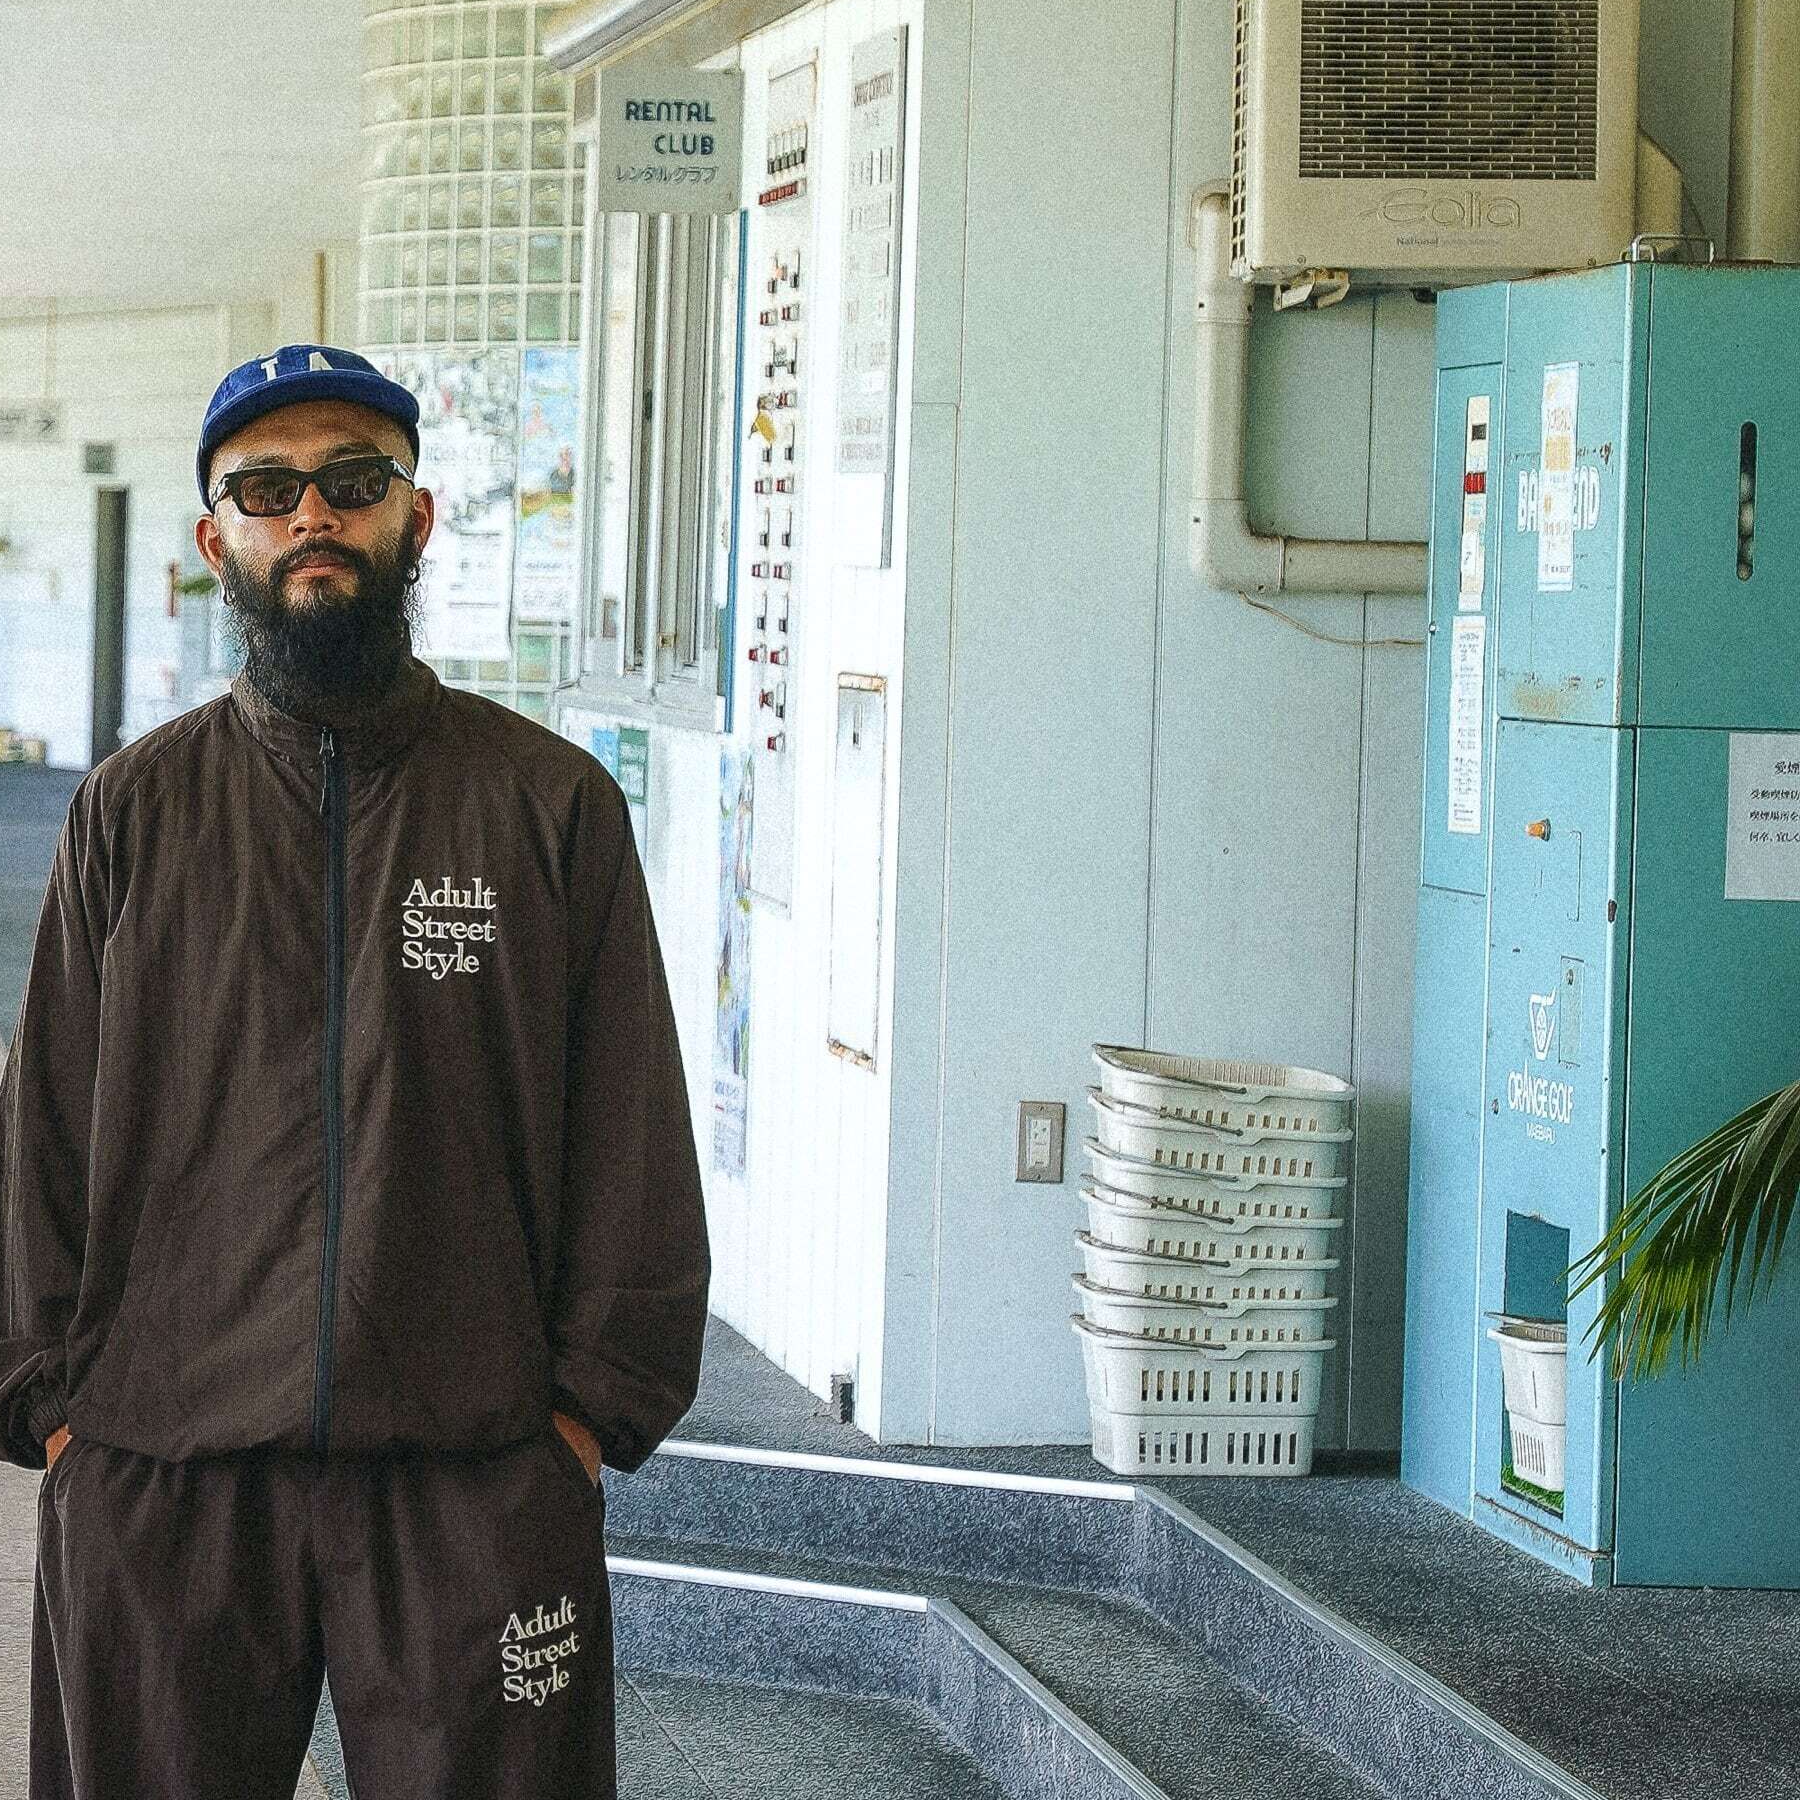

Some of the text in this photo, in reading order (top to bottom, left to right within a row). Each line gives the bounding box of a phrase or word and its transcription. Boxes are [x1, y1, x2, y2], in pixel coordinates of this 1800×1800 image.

[625, 100, 716, 122] RENTAL
[654, 134, 714, 155] CLUB
[616, 166, 718, 184] レンタルクラブ
[401, 876, 498, 910] Adult
[401, 909, 497, 942] Street
[401, 941, 480, 980] Style
[1508, 1059, 1574, 1125] ORANGE GOLF
[498, 1595, 577, 1643] Adult
[501, 1631, 580, 1673] Street
[503, 1663, 570, 1707] Style
